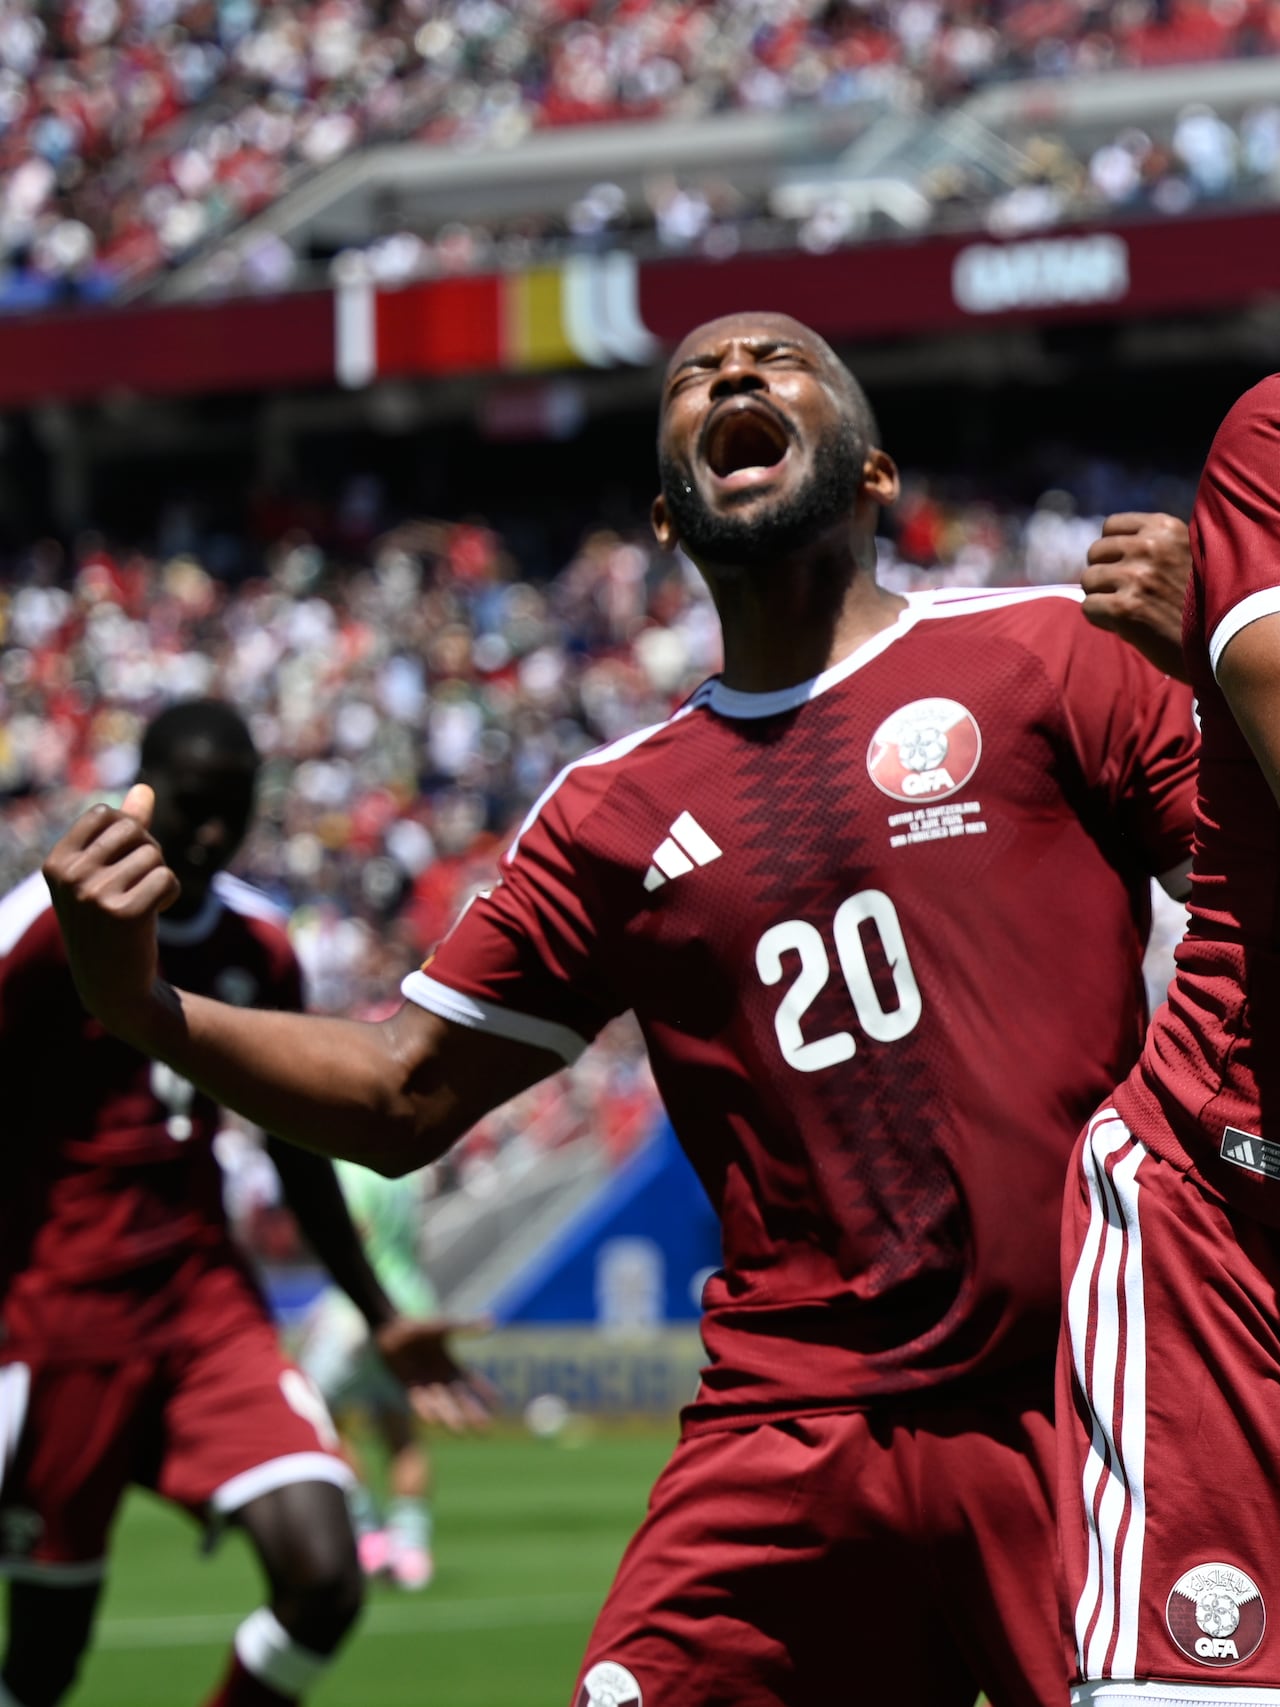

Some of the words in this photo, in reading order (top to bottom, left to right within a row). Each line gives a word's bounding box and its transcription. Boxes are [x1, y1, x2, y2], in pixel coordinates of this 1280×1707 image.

[902, 768, 955, 795] QFA
[755, 888, 922, 1072] 20
[1195, 1637, 1239, 1659] QFA
